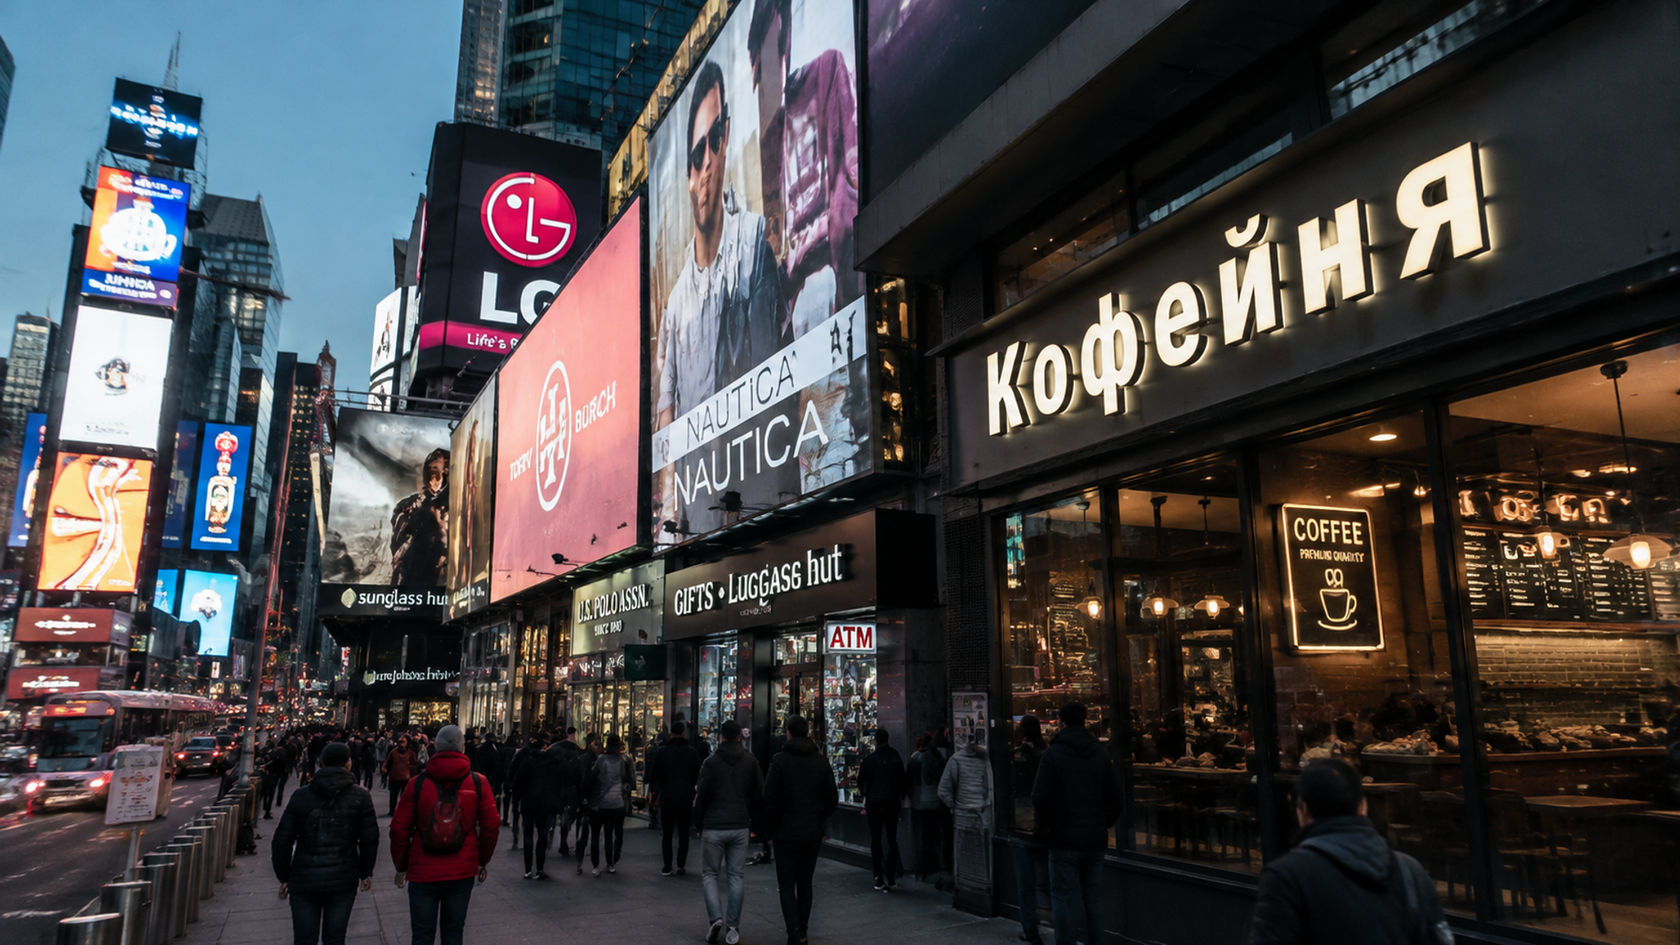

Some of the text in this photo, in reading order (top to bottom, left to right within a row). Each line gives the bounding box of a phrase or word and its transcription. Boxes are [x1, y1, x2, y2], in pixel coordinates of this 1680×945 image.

[987, 141, 1491, 435] Кофейня
[673, 399, 829, 512] NAUTICA
[1294, 517, 1363, 545] COFFEE
[674, 581, 714, 616] GIFTS
[807, 544, 843, 587] hut
[358, 589, 423, 609] sunglass
[594, 591, 618, 619] POLO
[619, 584, 649, 612] ASSN.
[830, 625, 873, 649] ATM
